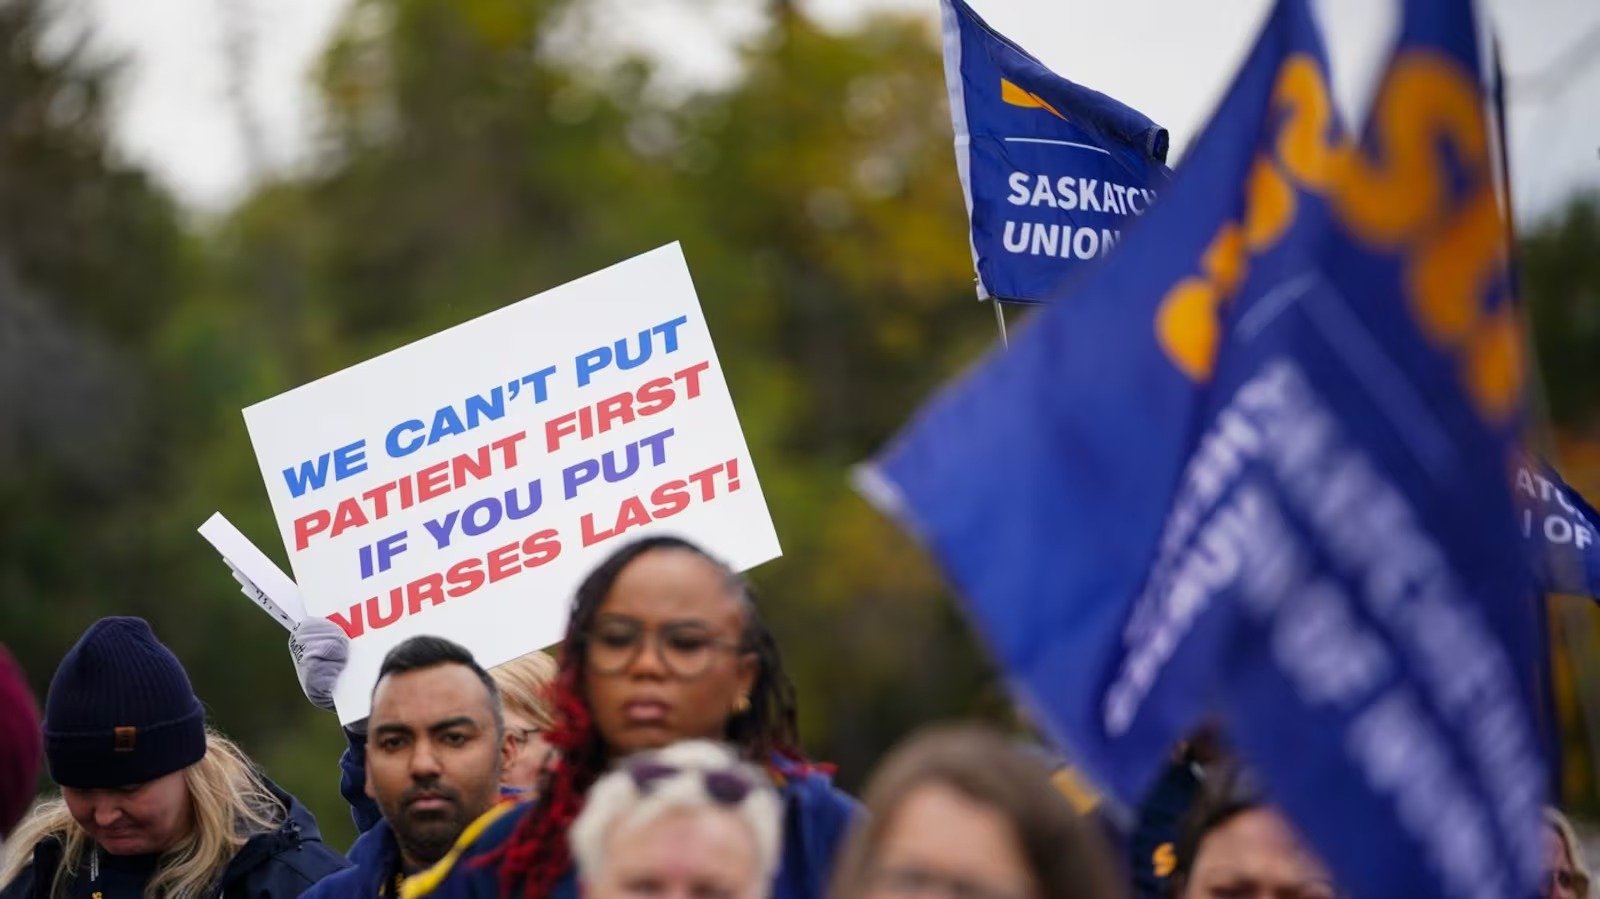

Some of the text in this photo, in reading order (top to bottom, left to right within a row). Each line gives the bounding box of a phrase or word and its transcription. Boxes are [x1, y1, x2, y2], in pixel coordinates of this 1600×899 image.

[282, 315, 688, 499] WE CAN’T PUT
[294, 361, 709, 551] PATIENT FIRST
[326, 528, 562, 640] NURSES
[580, 458, 741, 547] LAST!
[359, 428, 675, 579] IF YOU PUT
